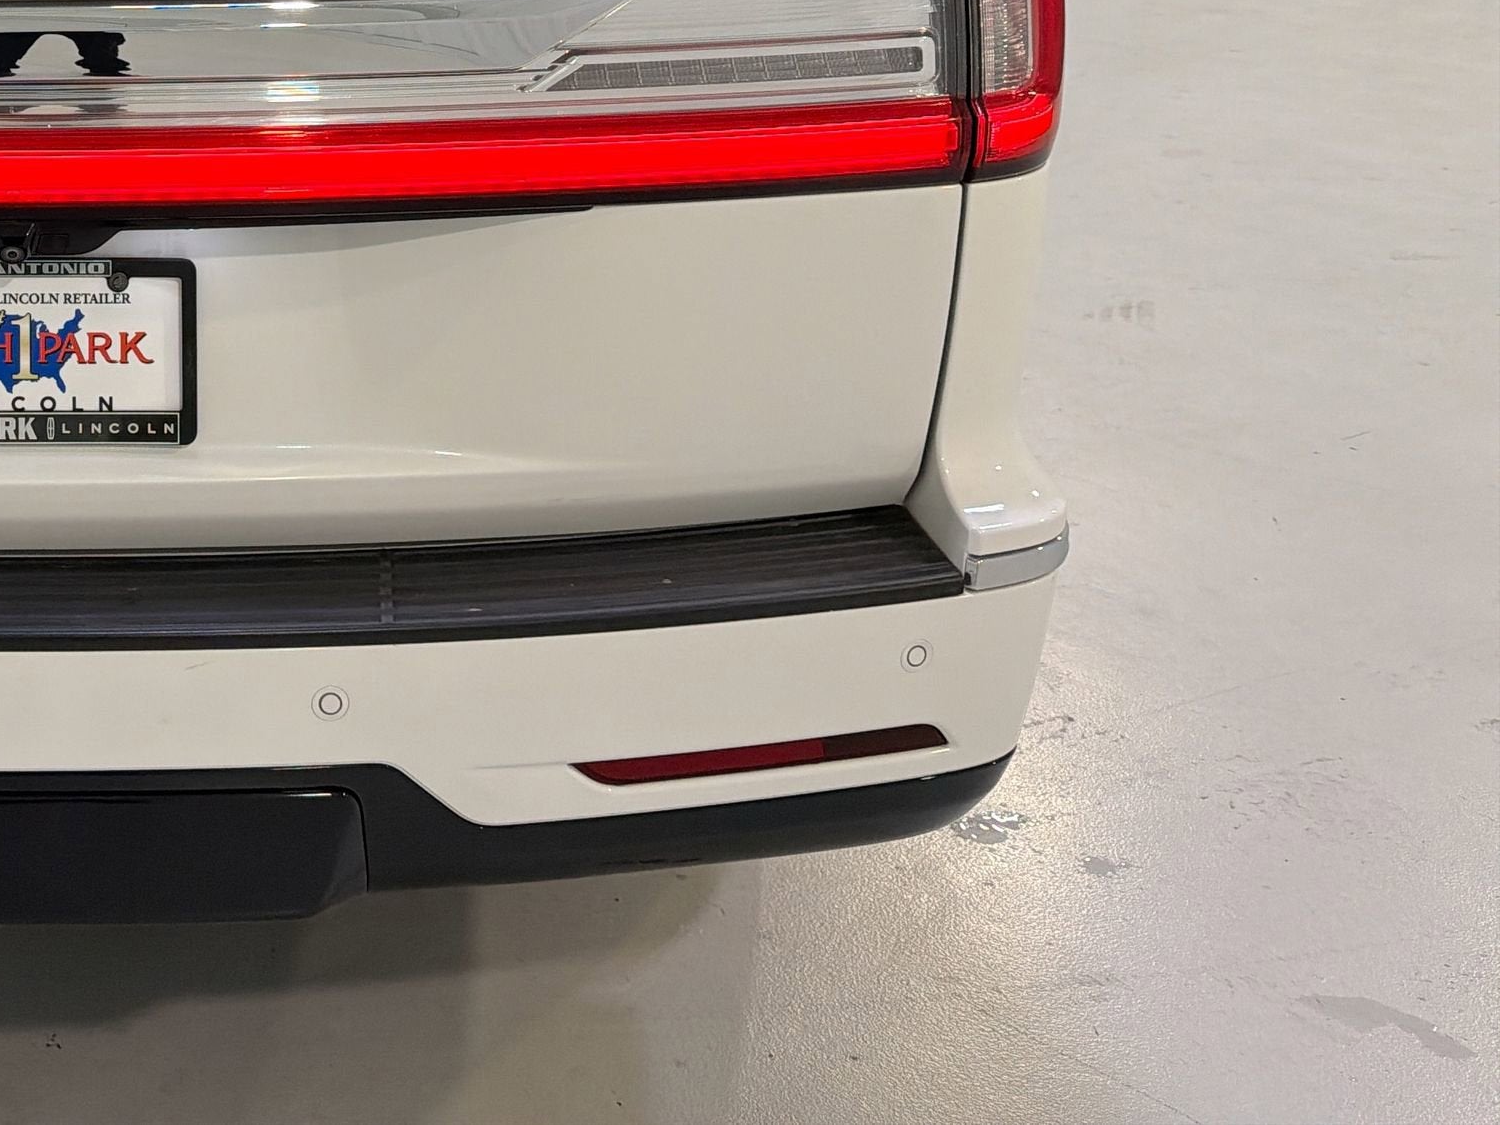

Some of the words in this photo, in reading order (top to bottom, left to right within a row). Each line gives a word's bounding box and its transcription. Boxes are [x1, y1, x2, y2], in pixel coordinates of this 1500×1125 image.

[63, 292, 132, 305] RETAILER
[37, 331, 155, 364] PARK
[61, 421, 175, 435] LINCOLN
